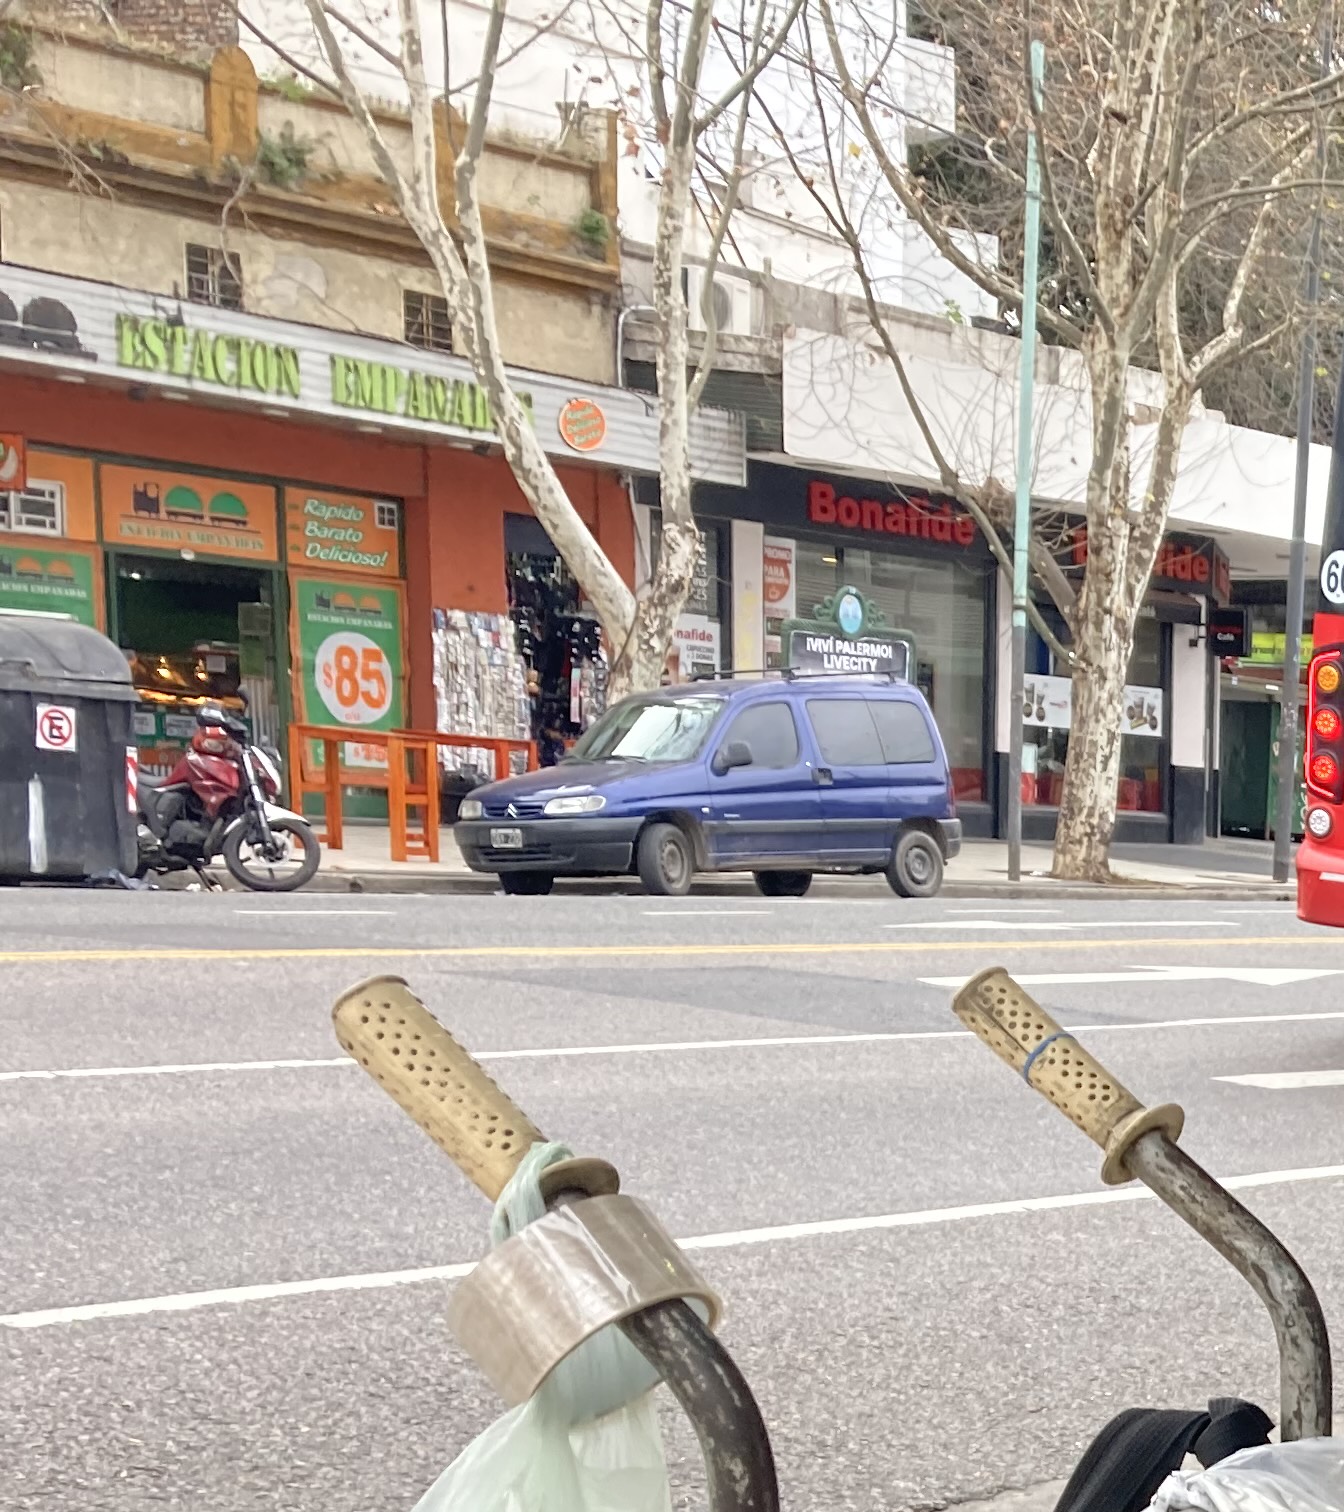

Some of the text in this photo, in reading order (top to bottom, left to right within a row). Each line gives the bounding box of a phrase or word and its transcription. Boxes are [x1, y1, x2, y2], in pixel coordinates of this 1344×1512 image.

[115, 312, 535, 434] ESTACION EMPANAD
[304, 498, 364, 523] Rapido
[808, 481, 976, 548] Bonafide
[304, 521, 364, 544] Barato
[305, 542, 389, 569] Delicioso!
[823, 654, 878, 673] LIVECITY
